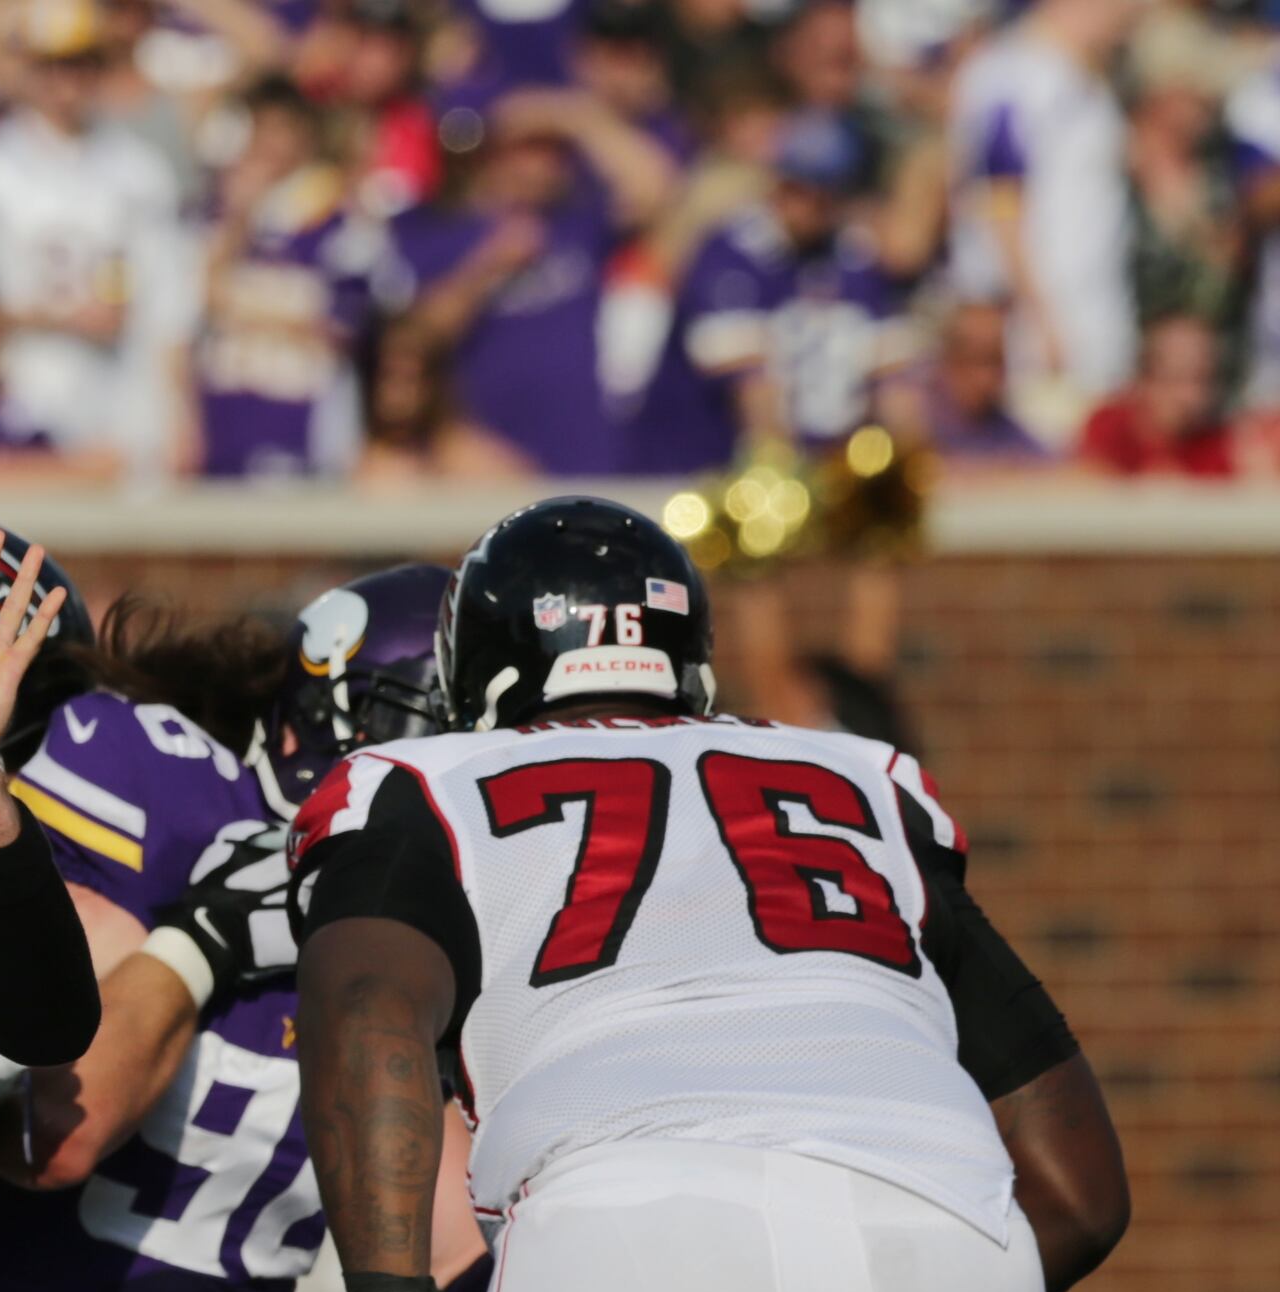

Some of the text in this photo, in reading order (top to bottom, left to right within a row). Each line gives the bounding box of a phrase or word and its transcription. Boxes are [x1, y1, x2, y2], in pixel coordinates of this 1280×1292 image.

[577, 603, 643, 646] 76
[564, 659, 666, 674] FALCONS
[477, 749, 922, 988] 76
